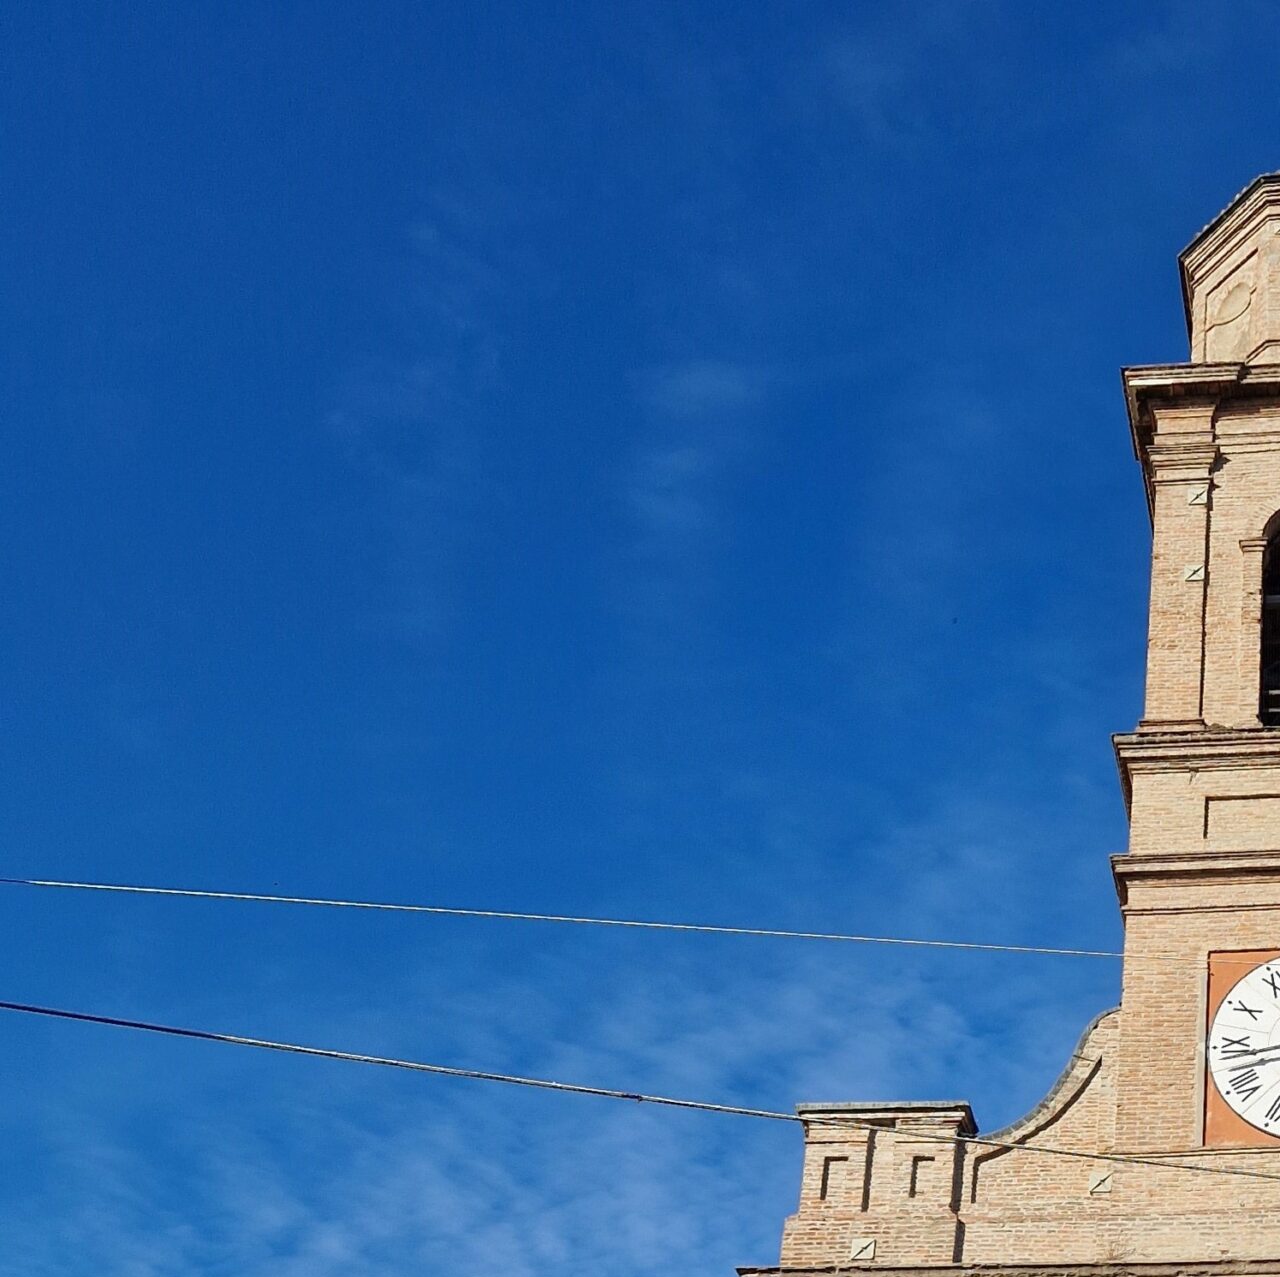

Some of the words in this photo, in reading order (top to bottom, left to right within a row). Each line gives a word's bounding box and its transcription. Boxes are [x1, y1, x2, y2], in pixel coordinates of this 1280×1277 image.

[1233, 1000, 1263, 1021] X
[1221, 1035, 1251, 1054] IX
[1228, 1069, 1263, 1102] VIII
